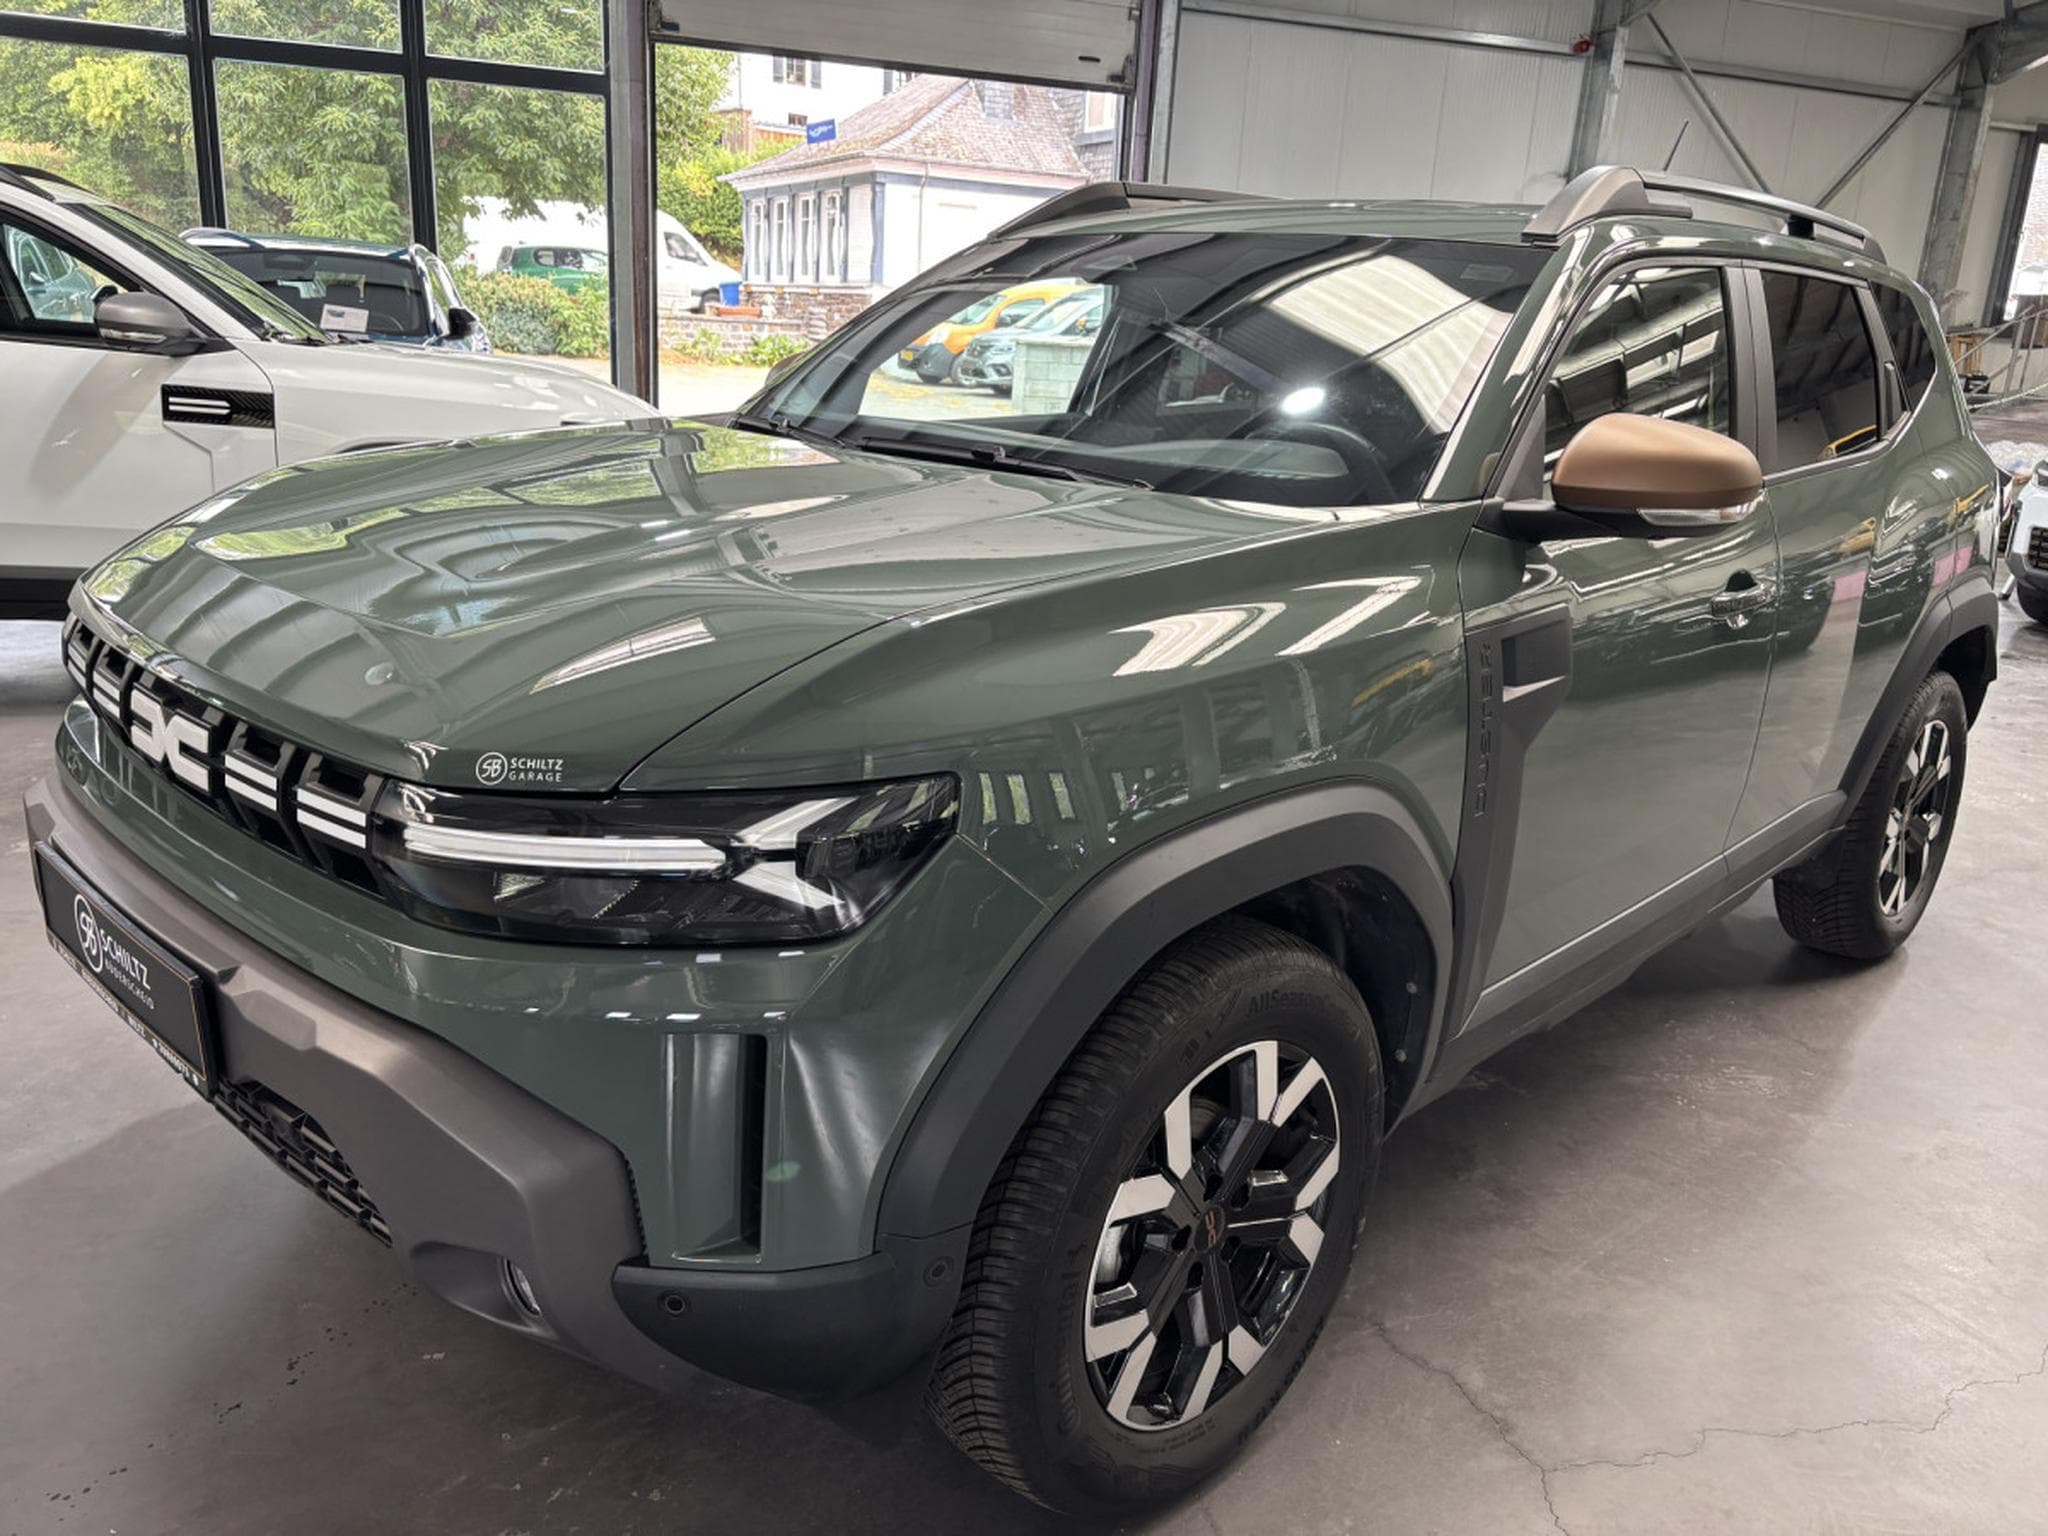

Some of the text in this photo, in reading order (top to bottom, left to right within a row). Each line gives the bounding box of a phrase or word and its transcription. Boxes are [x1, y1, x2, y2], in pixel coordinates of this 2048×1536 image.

[1473, 642, 1493, 818] DUSTER
[507, 770, 563, 783] GARAGE
[509, 757, 564, 771] SCHILTZ
[100, 928, 152, 991] SCHILTZ
